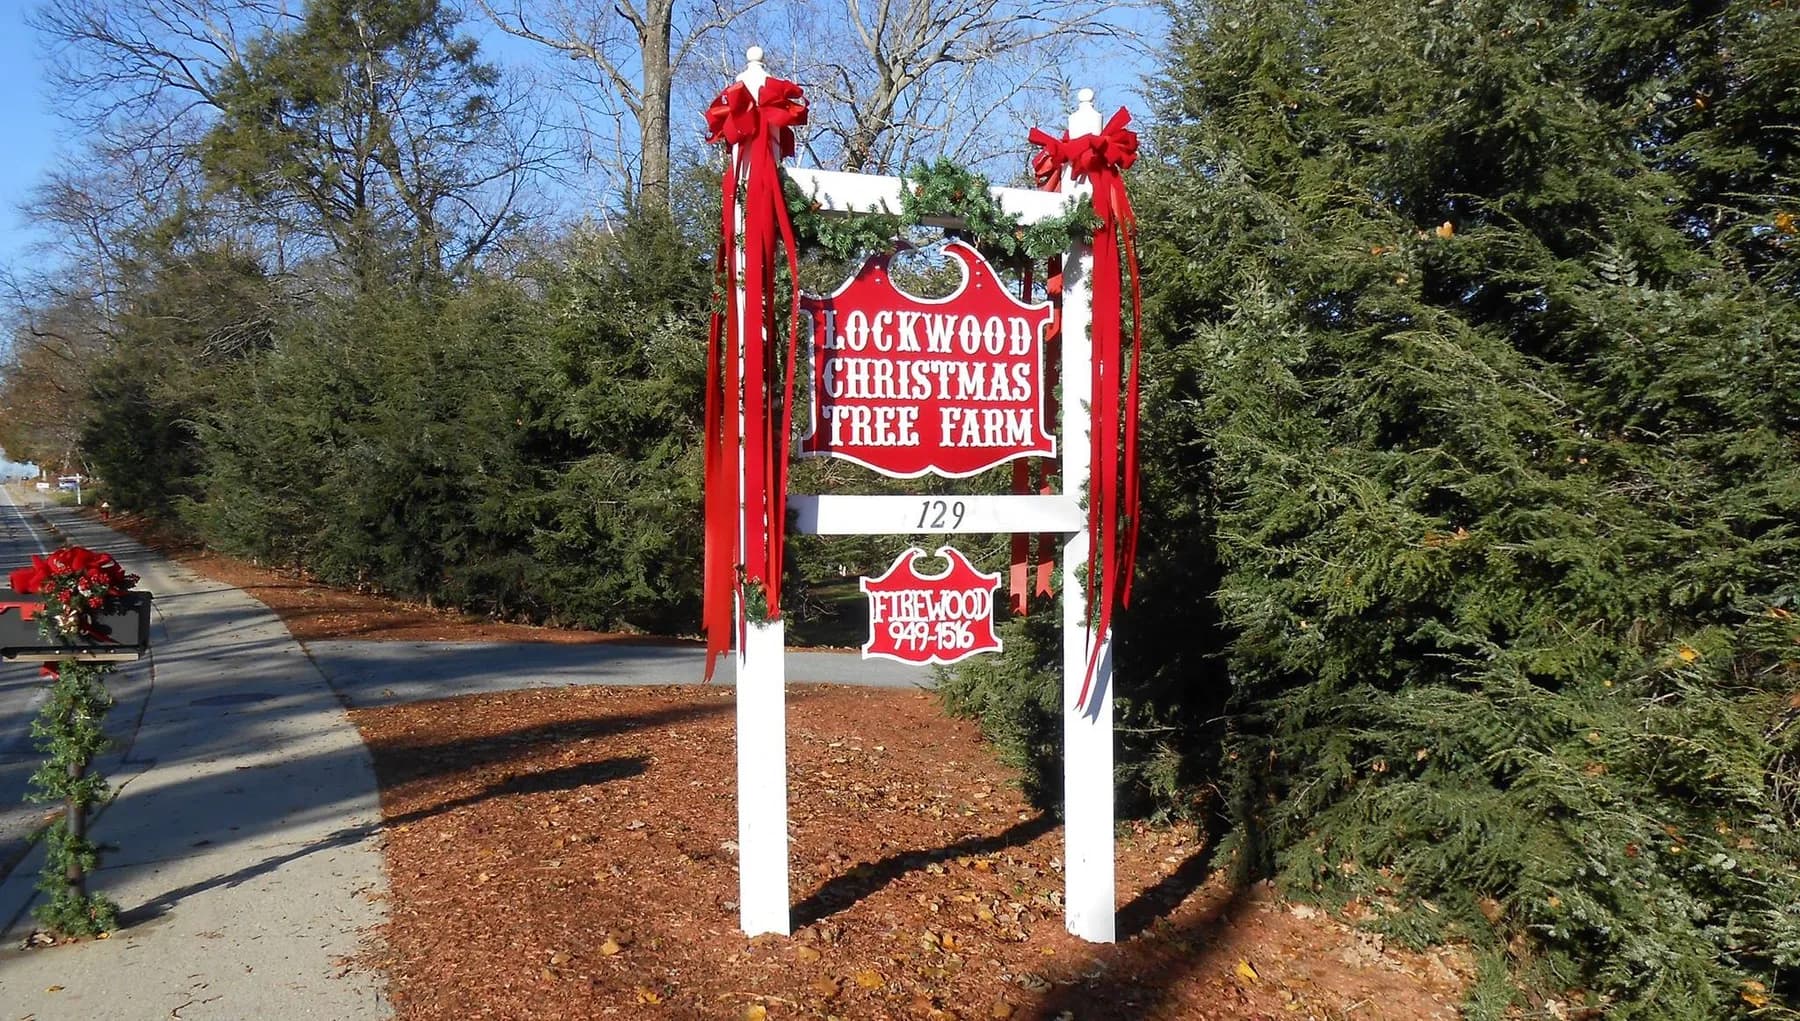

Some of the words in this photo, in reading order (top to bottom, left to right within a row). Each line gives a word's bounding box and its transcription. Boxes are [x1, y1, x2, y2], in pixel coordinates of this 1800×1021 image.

[823, 310, 1032, 355] LOCKWOOD
[823, 358, 1032, 401] CHRISTMAS
[823, 406, 920, 446] TREE
[940, 408, 1034, 447] FARM
[917, 501, 965, 529] 129
[872, 588, 991, 622] FIREWOOD
[889, 621, 974, 650] 949-1516
